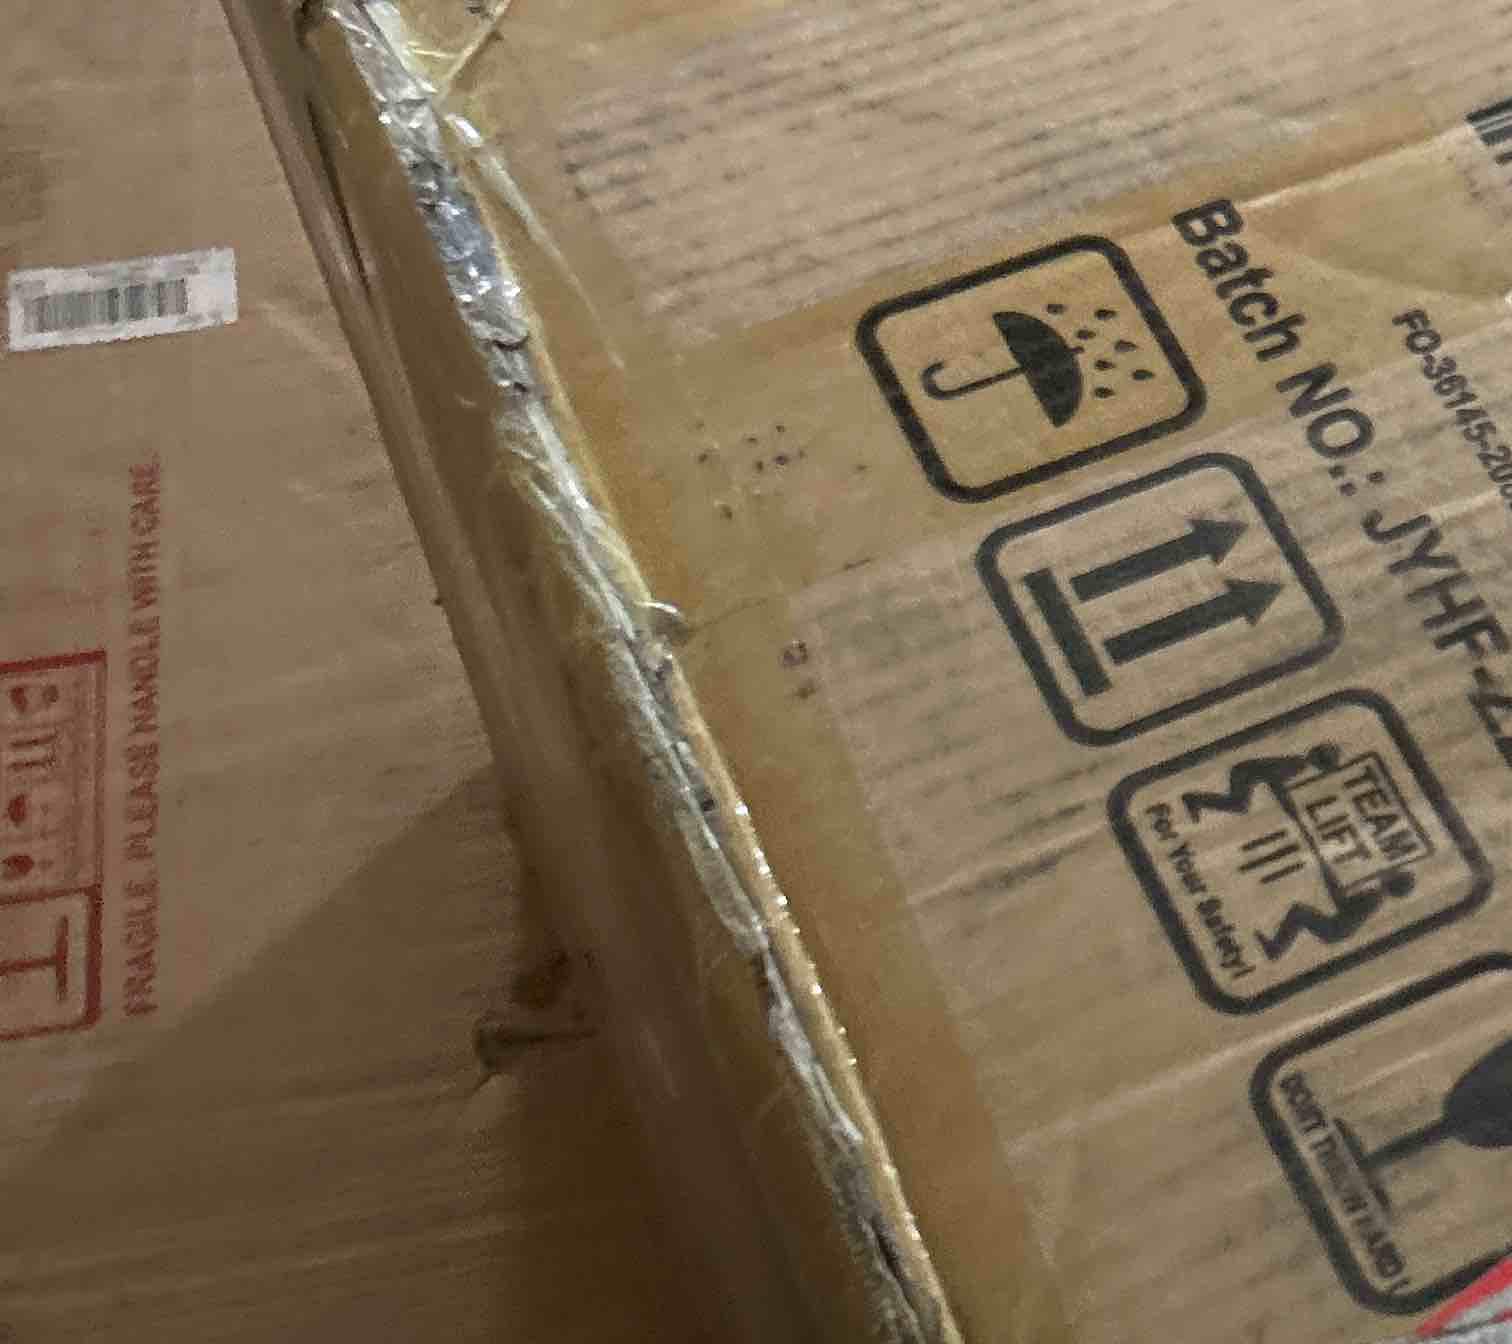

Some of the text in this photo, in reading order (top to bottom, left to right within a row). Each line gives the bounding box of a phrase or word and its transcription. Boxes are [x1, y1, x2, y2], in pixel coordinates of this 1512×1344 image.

[1170, 199, 1308, 362] Batch
[1305, 796, 1371, 864] LIFT
[1344, 765, 1418, 861] TEAM
